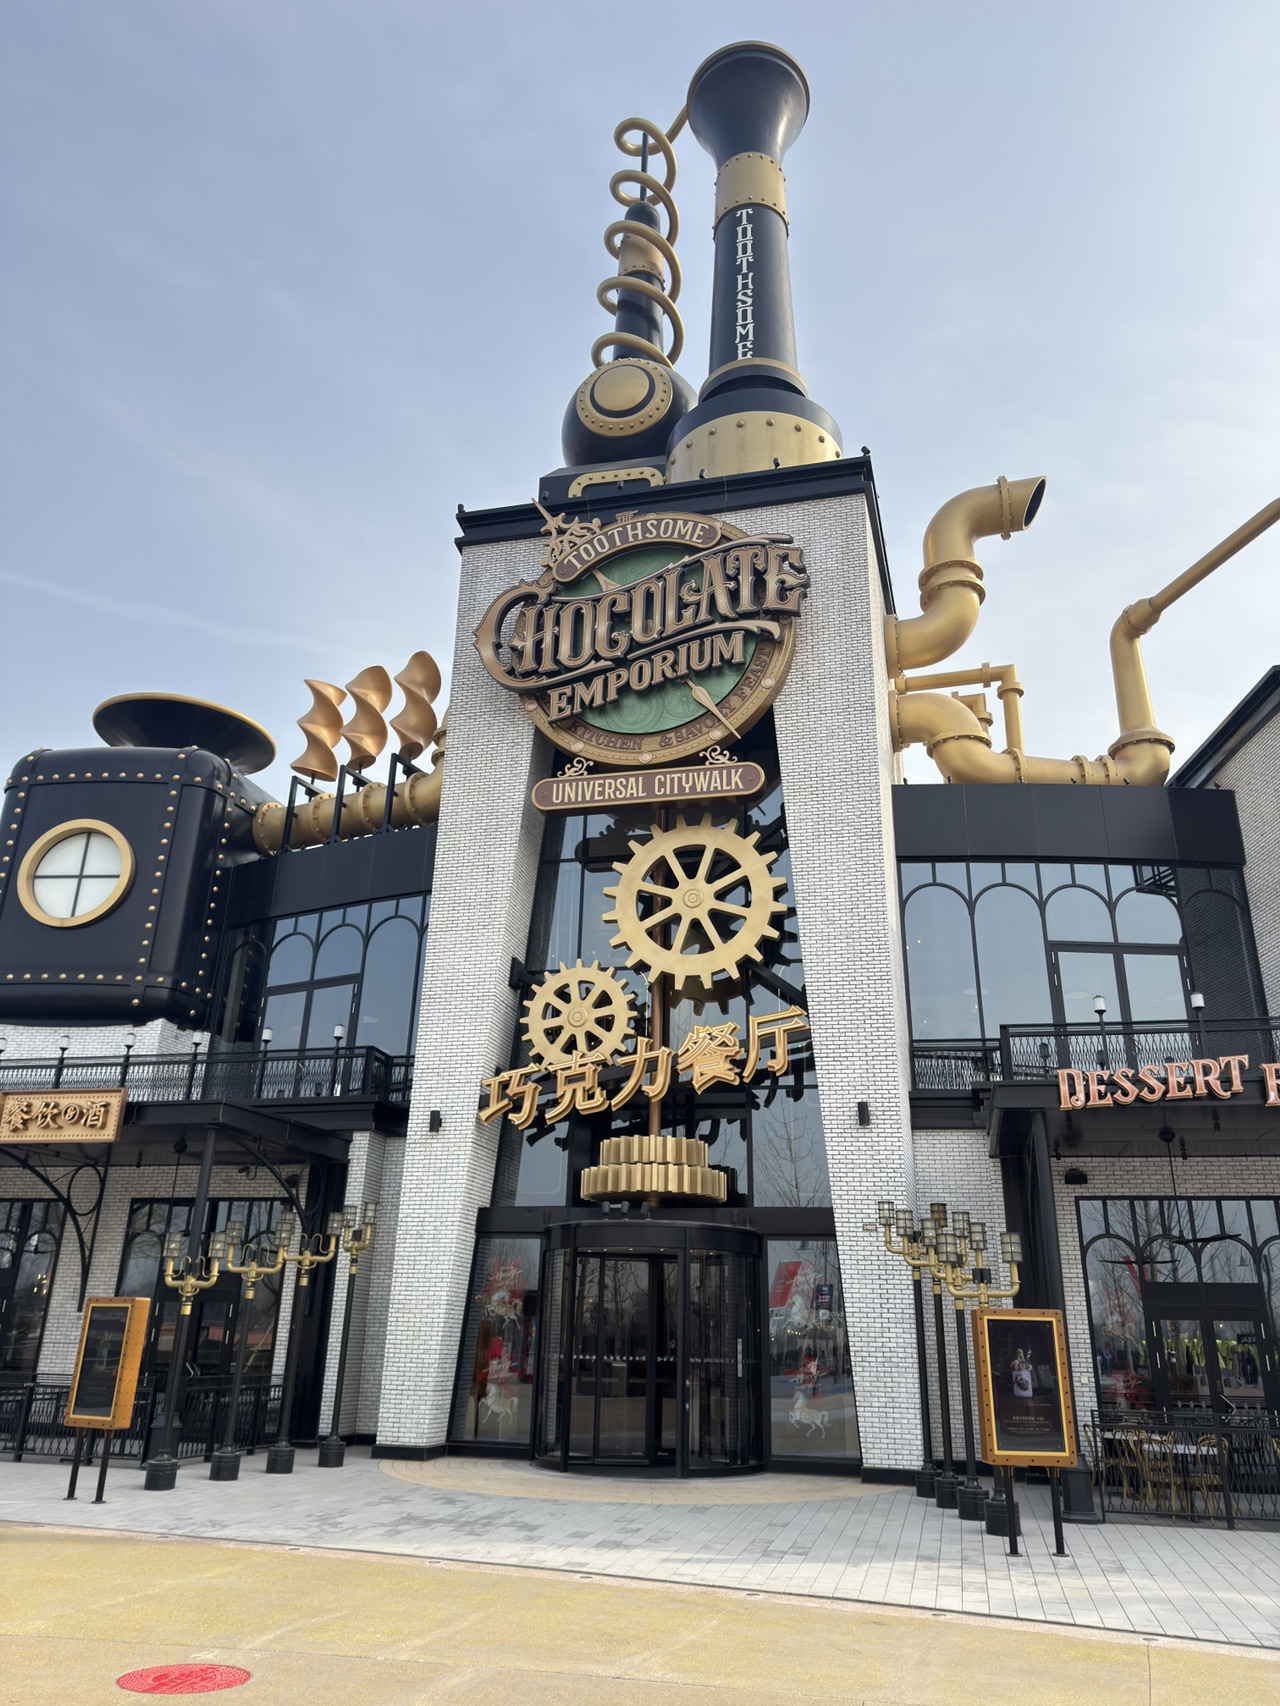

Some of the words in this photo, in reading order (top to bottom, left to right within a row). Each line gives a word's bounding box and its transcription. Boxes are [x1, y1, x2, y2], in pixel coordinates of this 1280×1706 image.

[735, 208, 755, 361] TOOTHSOME
[563, 519, 710, 571] TOOTHSOME
[615, 510, 639, 524] THE
[473, 545, 811, 692] CHOCOLATE
[548, 630, 746, 722] EMPORIUM
[566, 719, 645, 751] KITCHEN
[658, 735, 674, 748] &
[733, 647, 771, 702] FEAST
[552, 776, 647, 803] UNIVERSAL
[654, 767, 744, 796] CITYWALK
[477, 1005, 811, 1130] 巧克力餐厅
[1056, 1054, 1249, 1111] DESSERT
